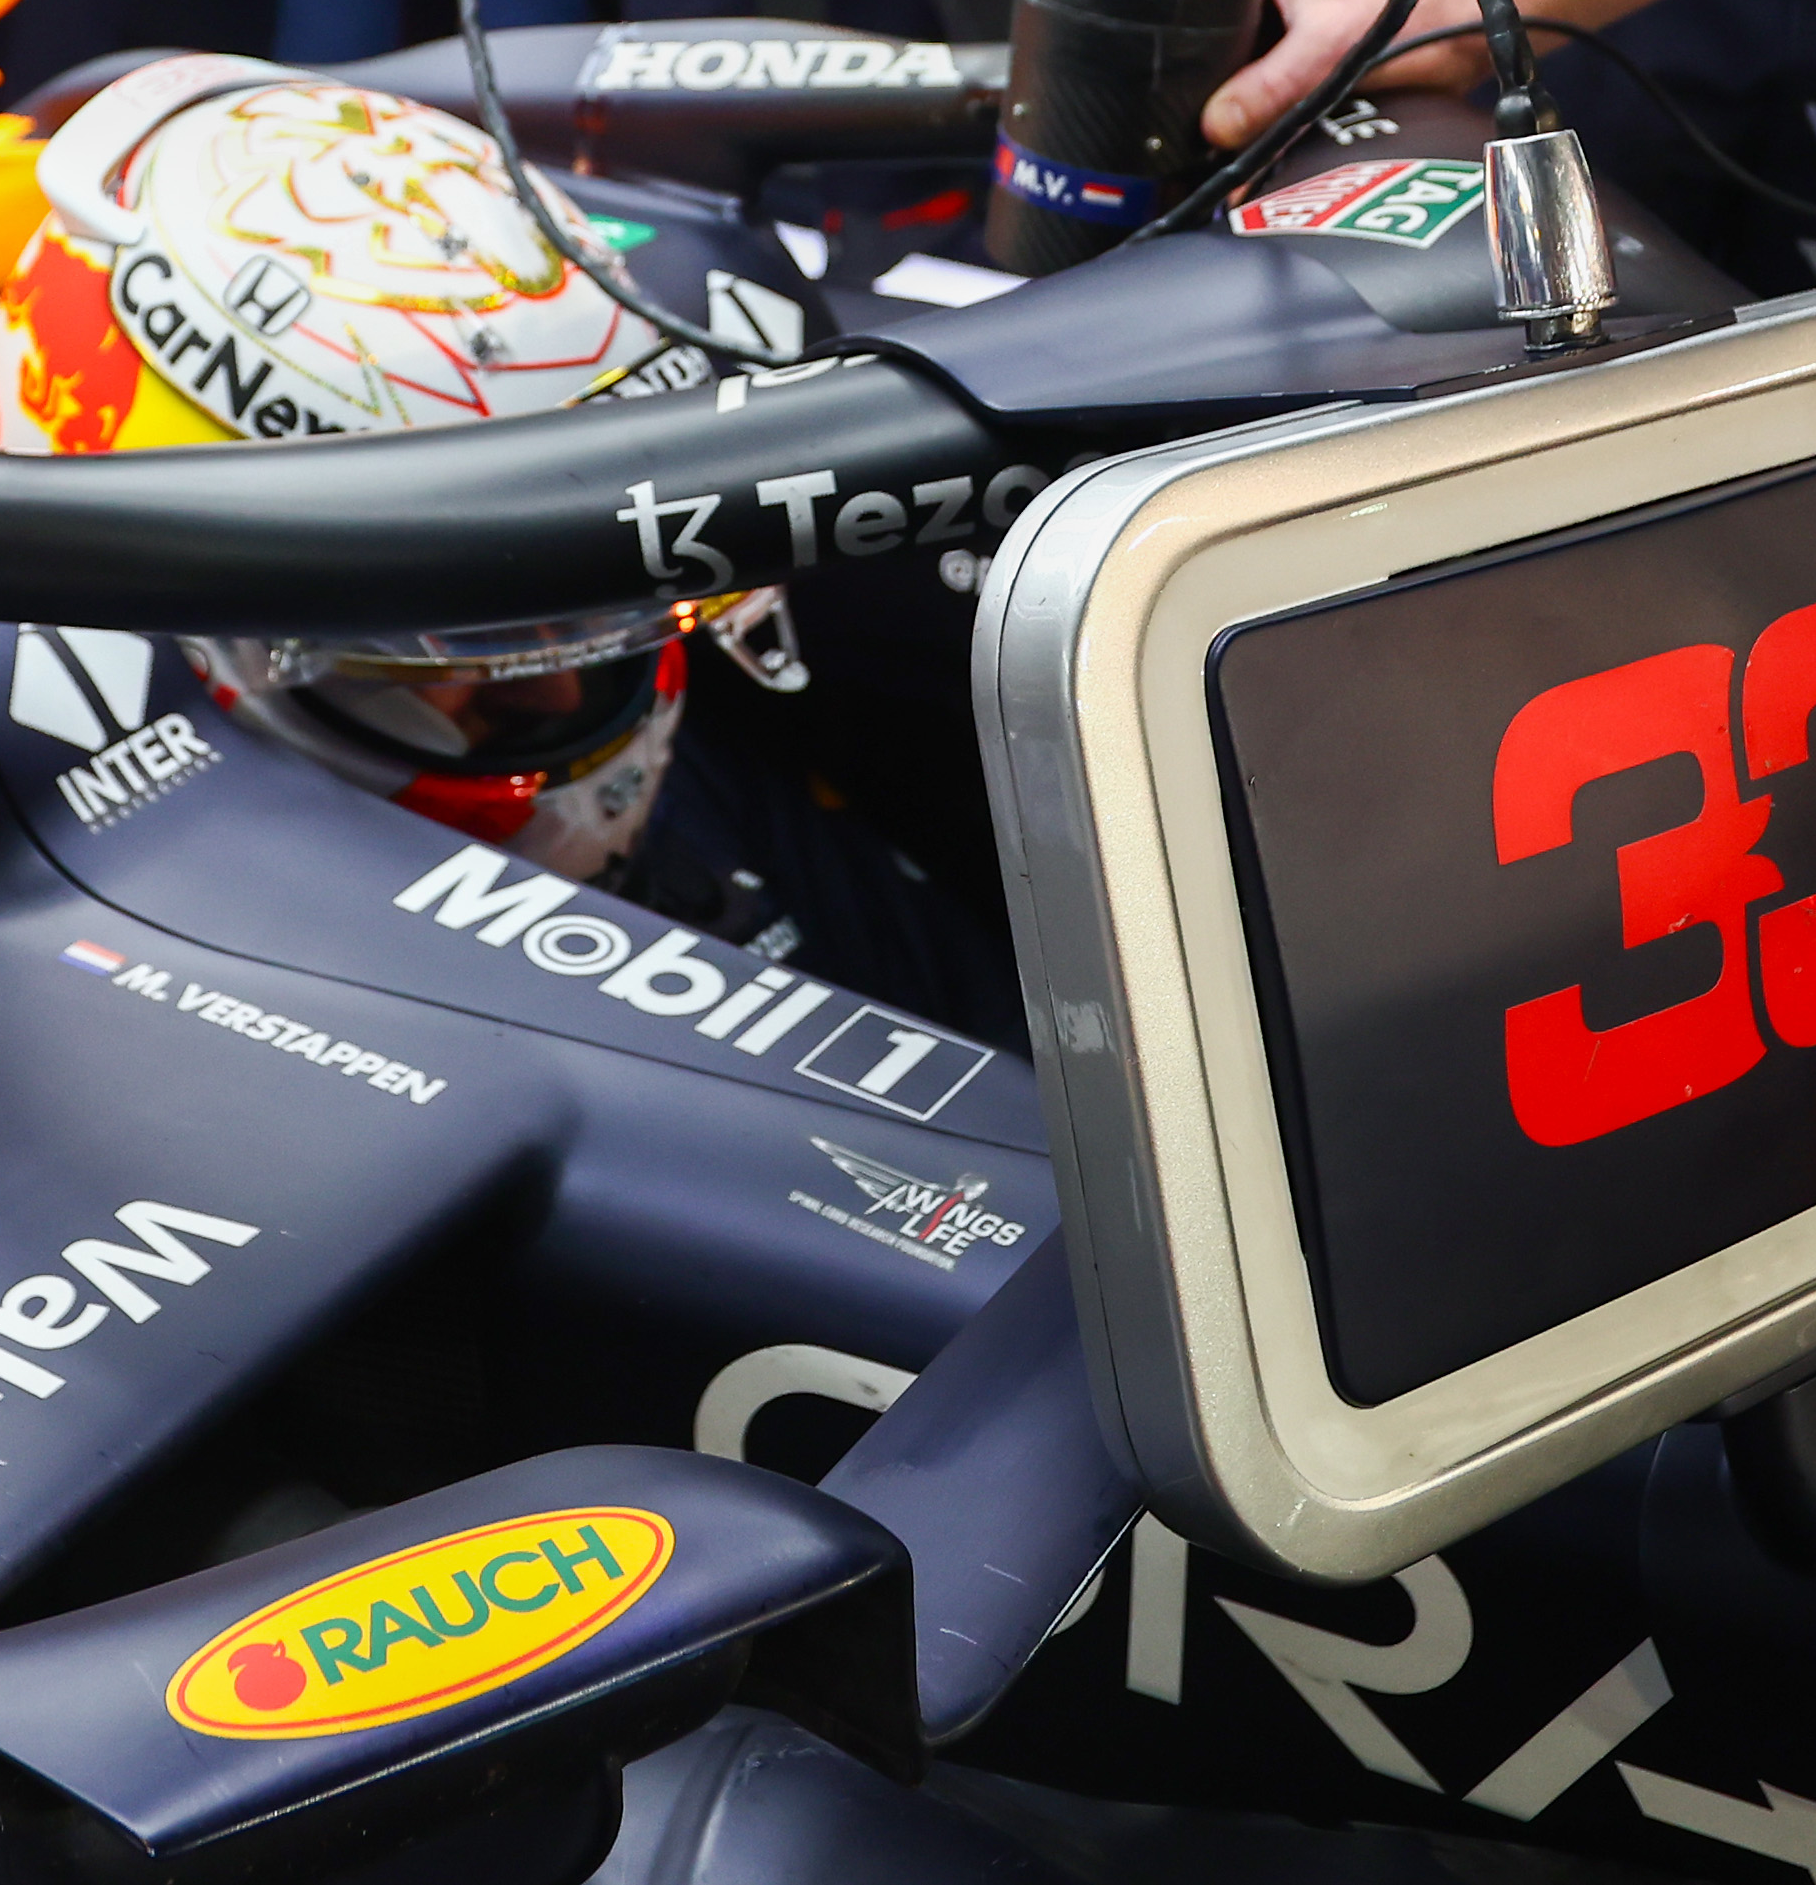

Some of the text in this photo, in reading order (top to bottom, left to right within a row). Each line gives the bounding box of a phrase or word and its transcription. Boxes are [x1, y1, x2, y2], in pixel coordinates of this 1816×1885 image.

[595, 39, 963, 91] HONDA
[1012, 156, 1075, 204] M.V.
[1353, 168, 1485, 235] TAG
[121, 253, 371, 437] CarNex
[756, 449, 1107, 568] Tezo
[56, 712, 212, 824] INTER
[392, 842, 940, 1096] Mobil 1
[111, 962, 448, 1107] M. VERSTAPPEN
[899, 1212, 978, 1257] LIFE
[906, 1183, 1027, 1247] WINGS
[297, 1524, 626, 1687] RAUCH
